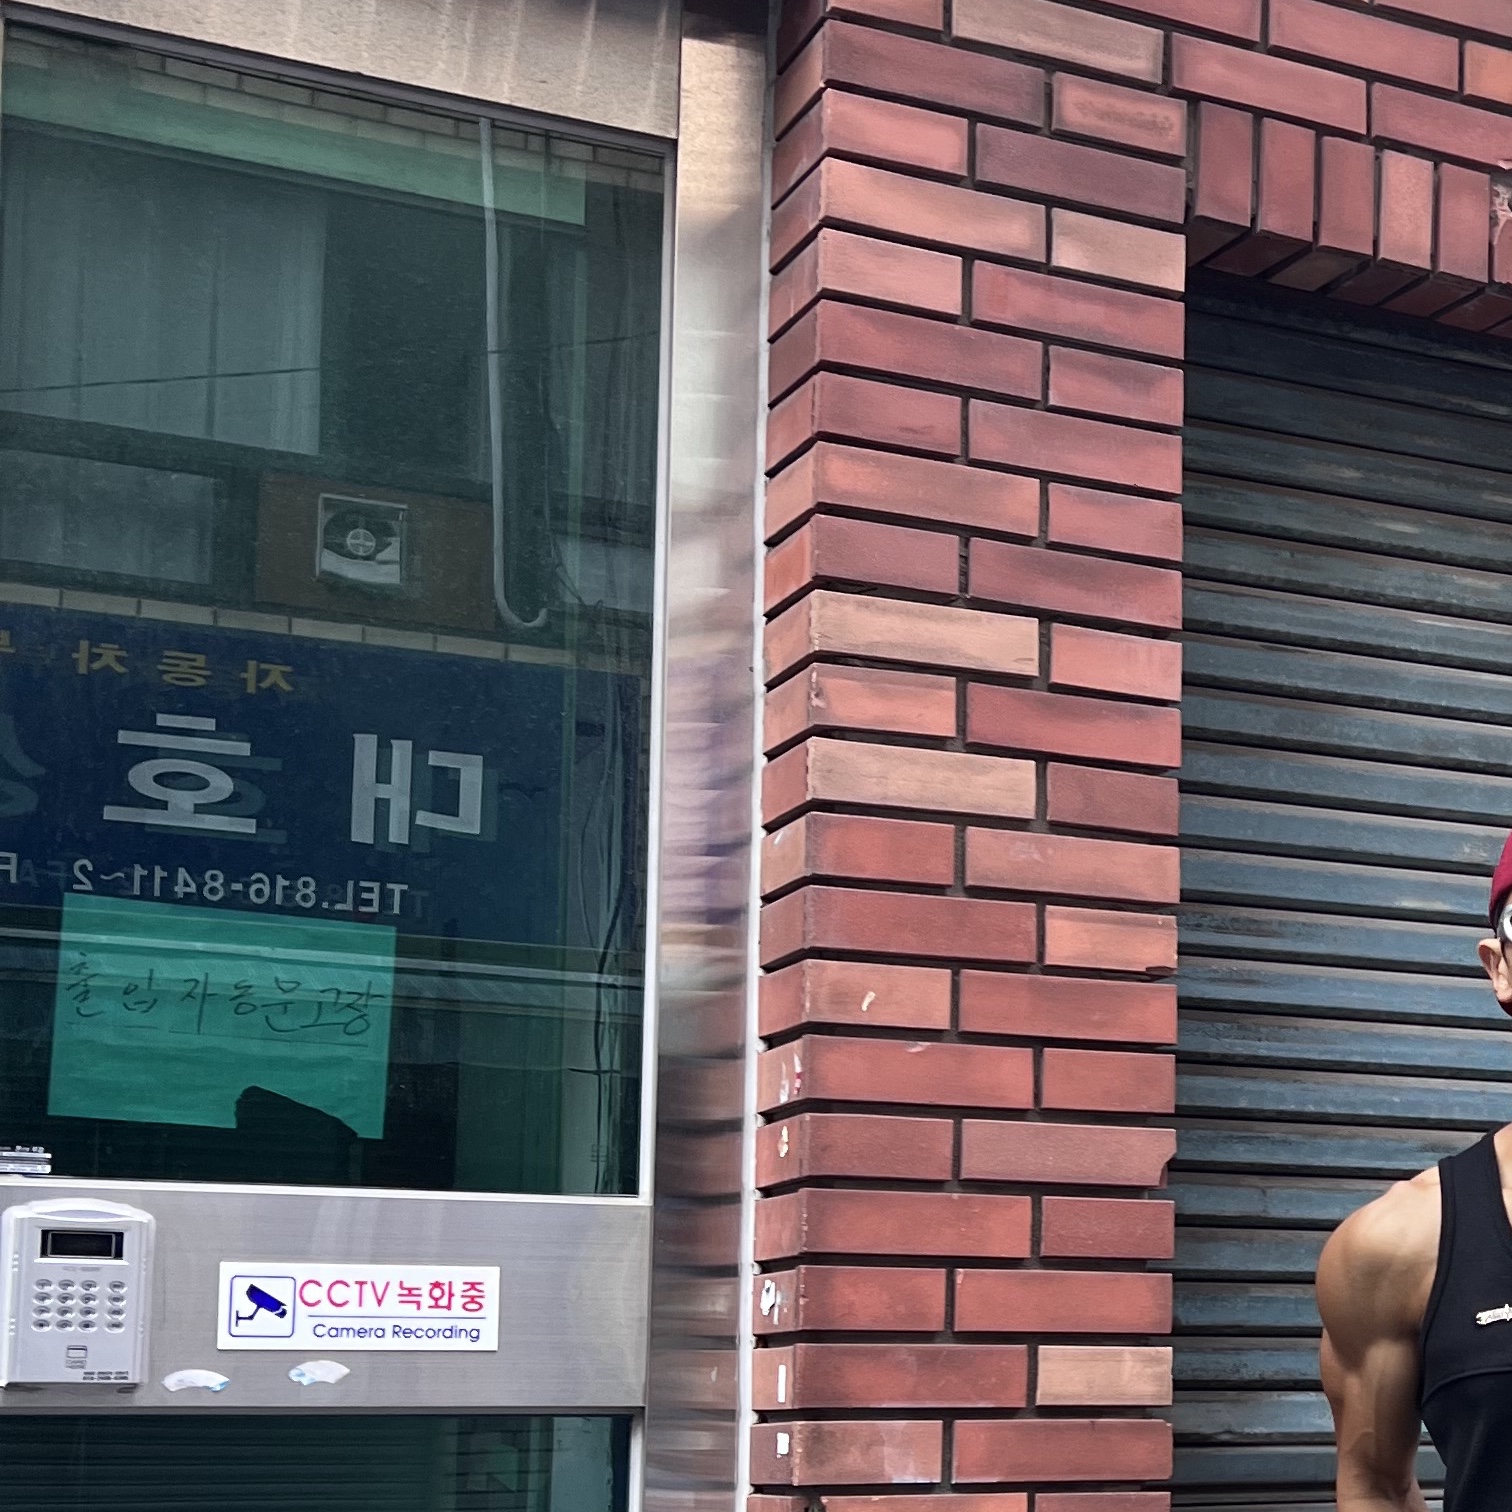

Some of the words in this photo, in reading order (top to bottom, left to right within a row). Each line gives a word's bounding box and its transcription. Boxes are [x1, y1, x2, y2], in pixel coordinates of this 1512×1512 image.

[298, 1279, 391, 1308] CCTV
[396, 1280, 487, 1313] 녹화중
[312, 1323, 386, 1339] Camera
[391, 1323, 481, 1343] Recording
